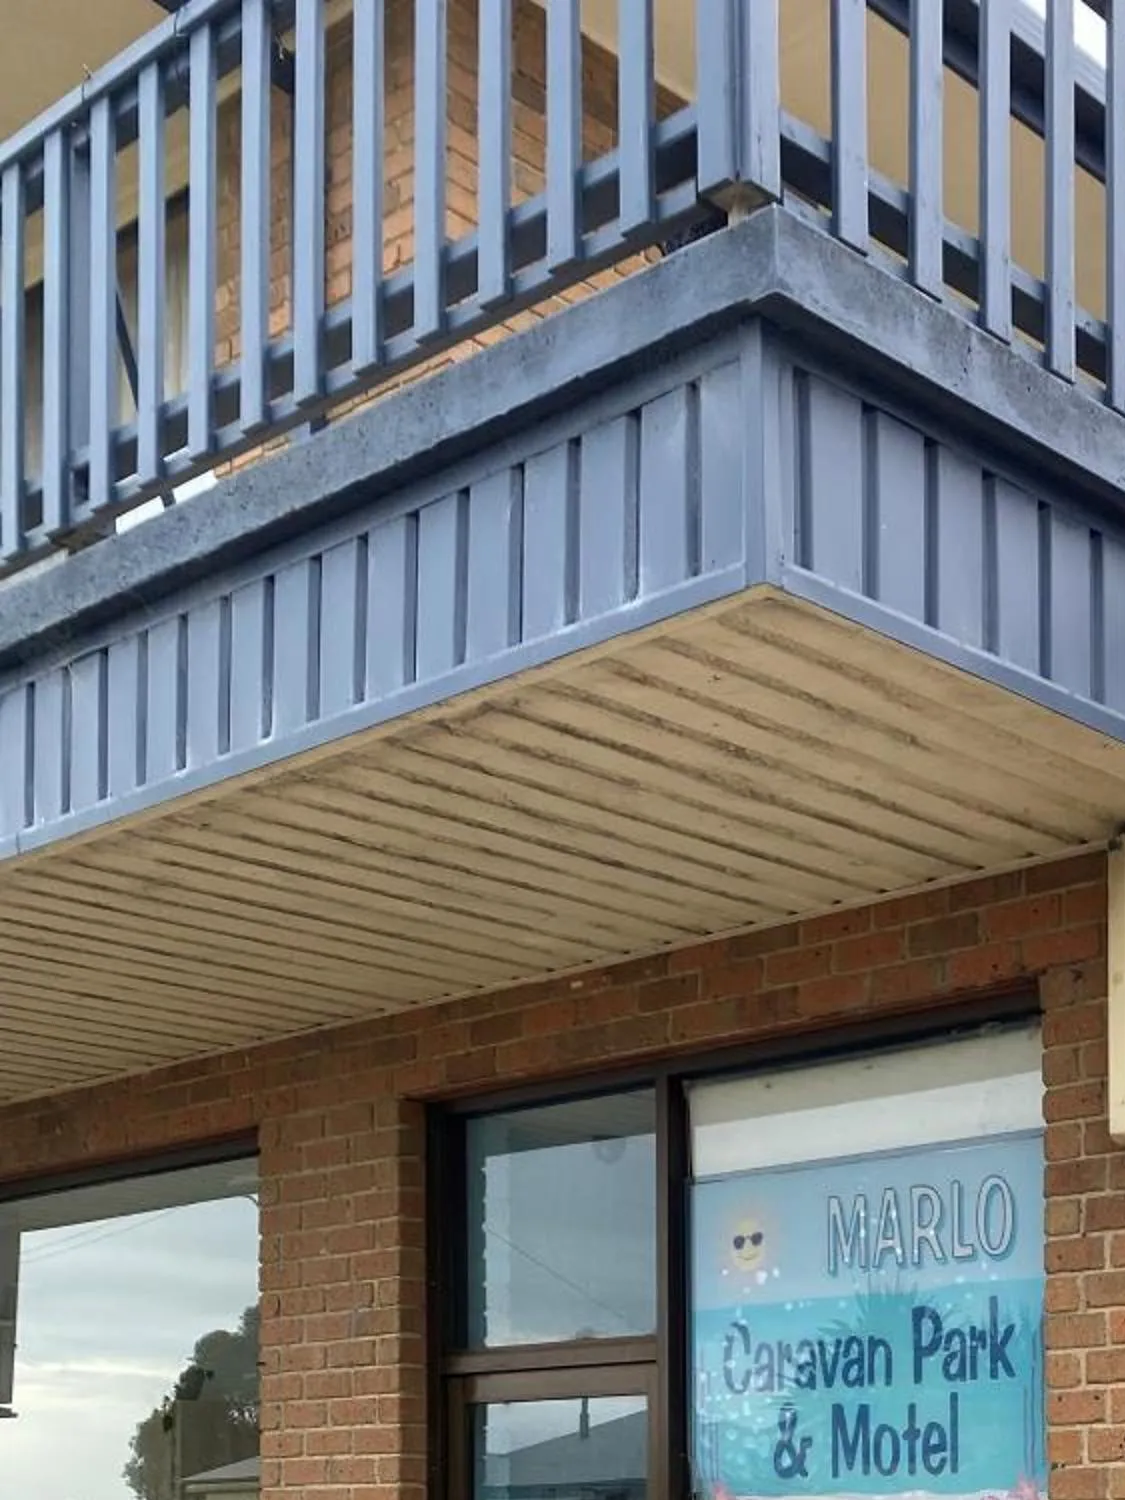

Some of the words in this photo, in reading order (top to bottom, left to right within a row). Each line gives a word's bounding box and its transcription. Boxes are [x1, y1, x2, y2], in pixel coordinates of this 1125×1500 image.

[826, 1173, 1017, 1275] MARLO
[722, 1321, 893, 1395] Caravan
[911, 1296, 1017, 1385] Park
[772, 1402, 813, 1479] &
[831, 1393, 960, 1479] Motel
